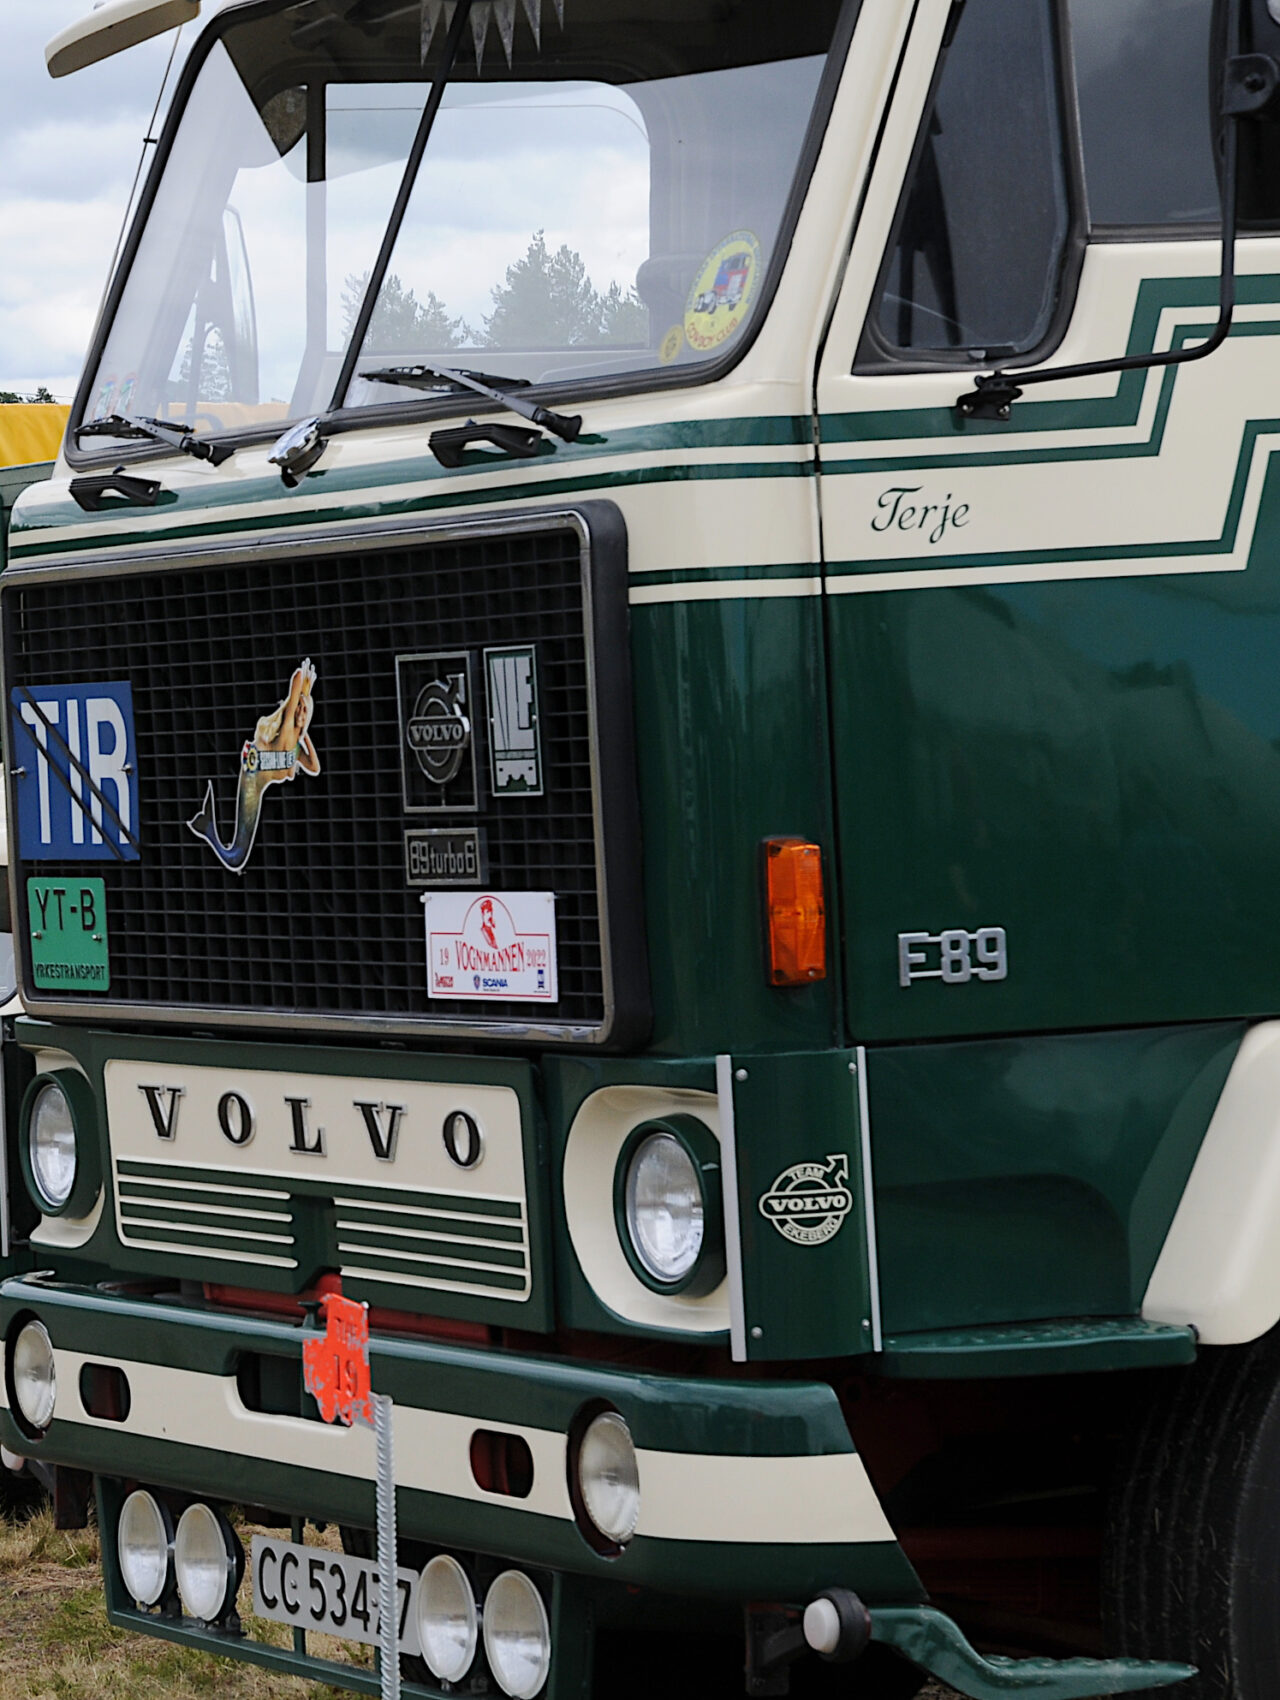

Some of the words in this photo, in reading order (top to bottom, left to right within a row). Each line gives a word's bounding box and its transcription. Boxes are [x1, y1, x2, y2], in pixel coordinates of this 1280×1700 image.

[871, 485, 970, 544] Terje
[410, 723, 463, 742] VOLVO
[21, 697, 131, 845] TIR
[35, 887, 97, 931] YT-B
[440, 947, 450, 966] 19
[455, 940, 525, 972] VOGNMANNEN
[526, 949, 546, 967] 2022
[898, 927, 1007, 987] F89
[34, 963, 106, 981] YRKESTRANSPORT
[482, 978, 508, 987] SCANIA
[138, 1083, 486, 1170] VOLVO
[787, 1167, 825, 1181] TEAM
[767, 1194, 846, 1213] VOLVO
[782, 1217, 838, 1241] EKEBERG
